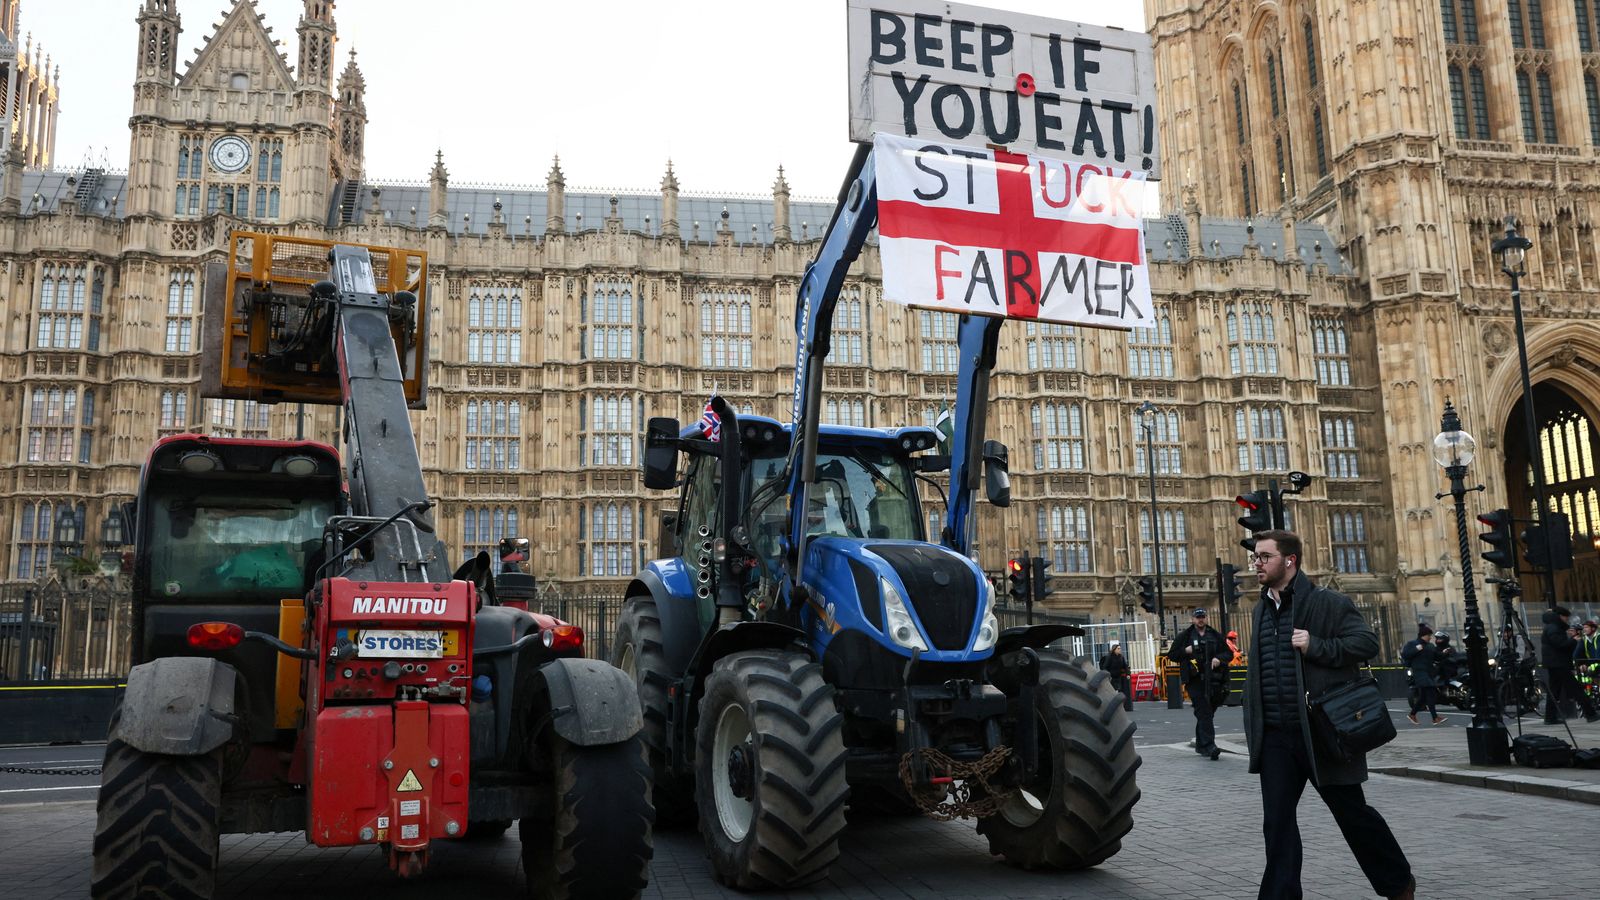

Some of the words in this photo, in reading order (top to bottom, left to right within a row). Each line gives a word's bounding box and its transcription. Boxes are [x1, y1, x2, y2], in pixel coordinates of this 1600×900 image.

[870, 9, 1014, 78] BEEP
[1049, 33, 1101, 92] IF
[891, 71, 1021, 144] YOU
[1034, 92, 1154, 170] EAT!
[934, 244, 1144, 319] FARMER
[797, 297, 810, 379] HOLLAND
[352, 597, 447, 615] MANITOU
[365, 637, 438, 651] STORES
